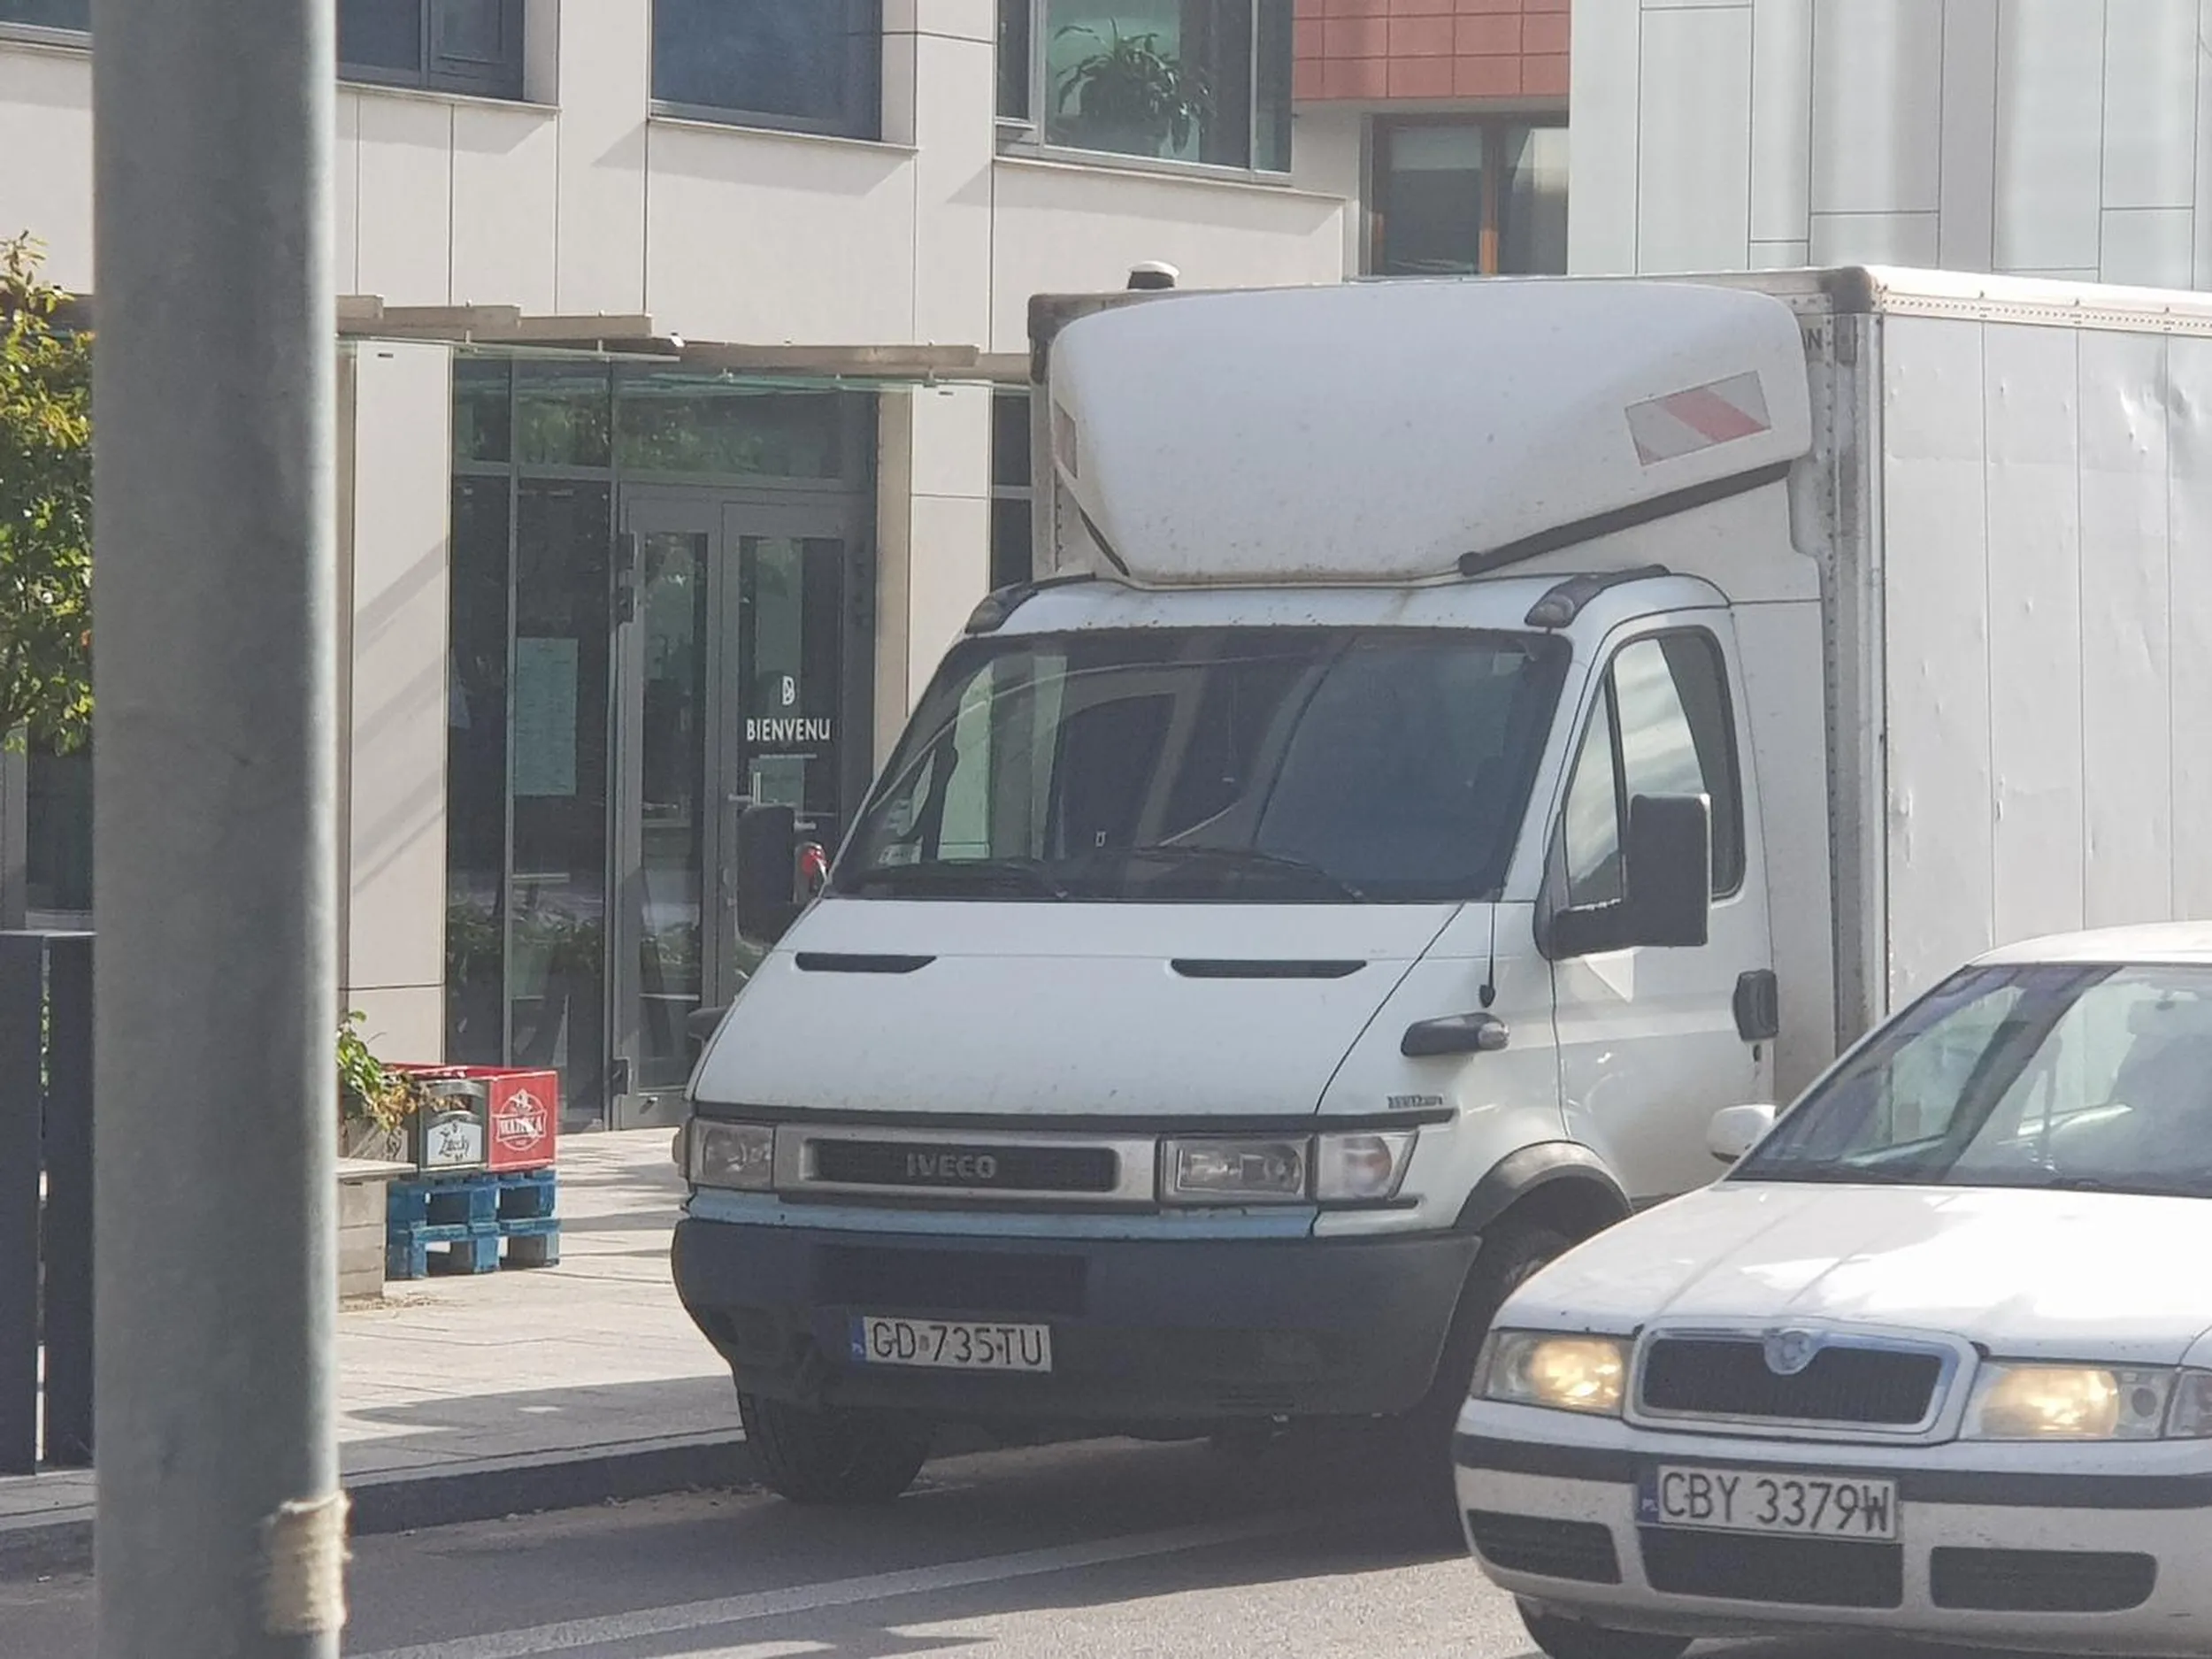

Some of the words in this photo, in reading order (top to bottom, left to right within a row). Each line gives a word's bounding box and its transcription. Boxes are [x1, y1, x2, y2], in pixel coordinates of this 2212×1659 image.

[746, 718, 831, 741] BIENVENU
[906, 1152, 998, 1179] IVECO
[872, 1321, 918, 1360] GD
[929, 1324, 1042, 1366] 735TU
[1662, 1471, 1741, 1523] CBY
[1755, 1478, 1889, 1532] 3379W
